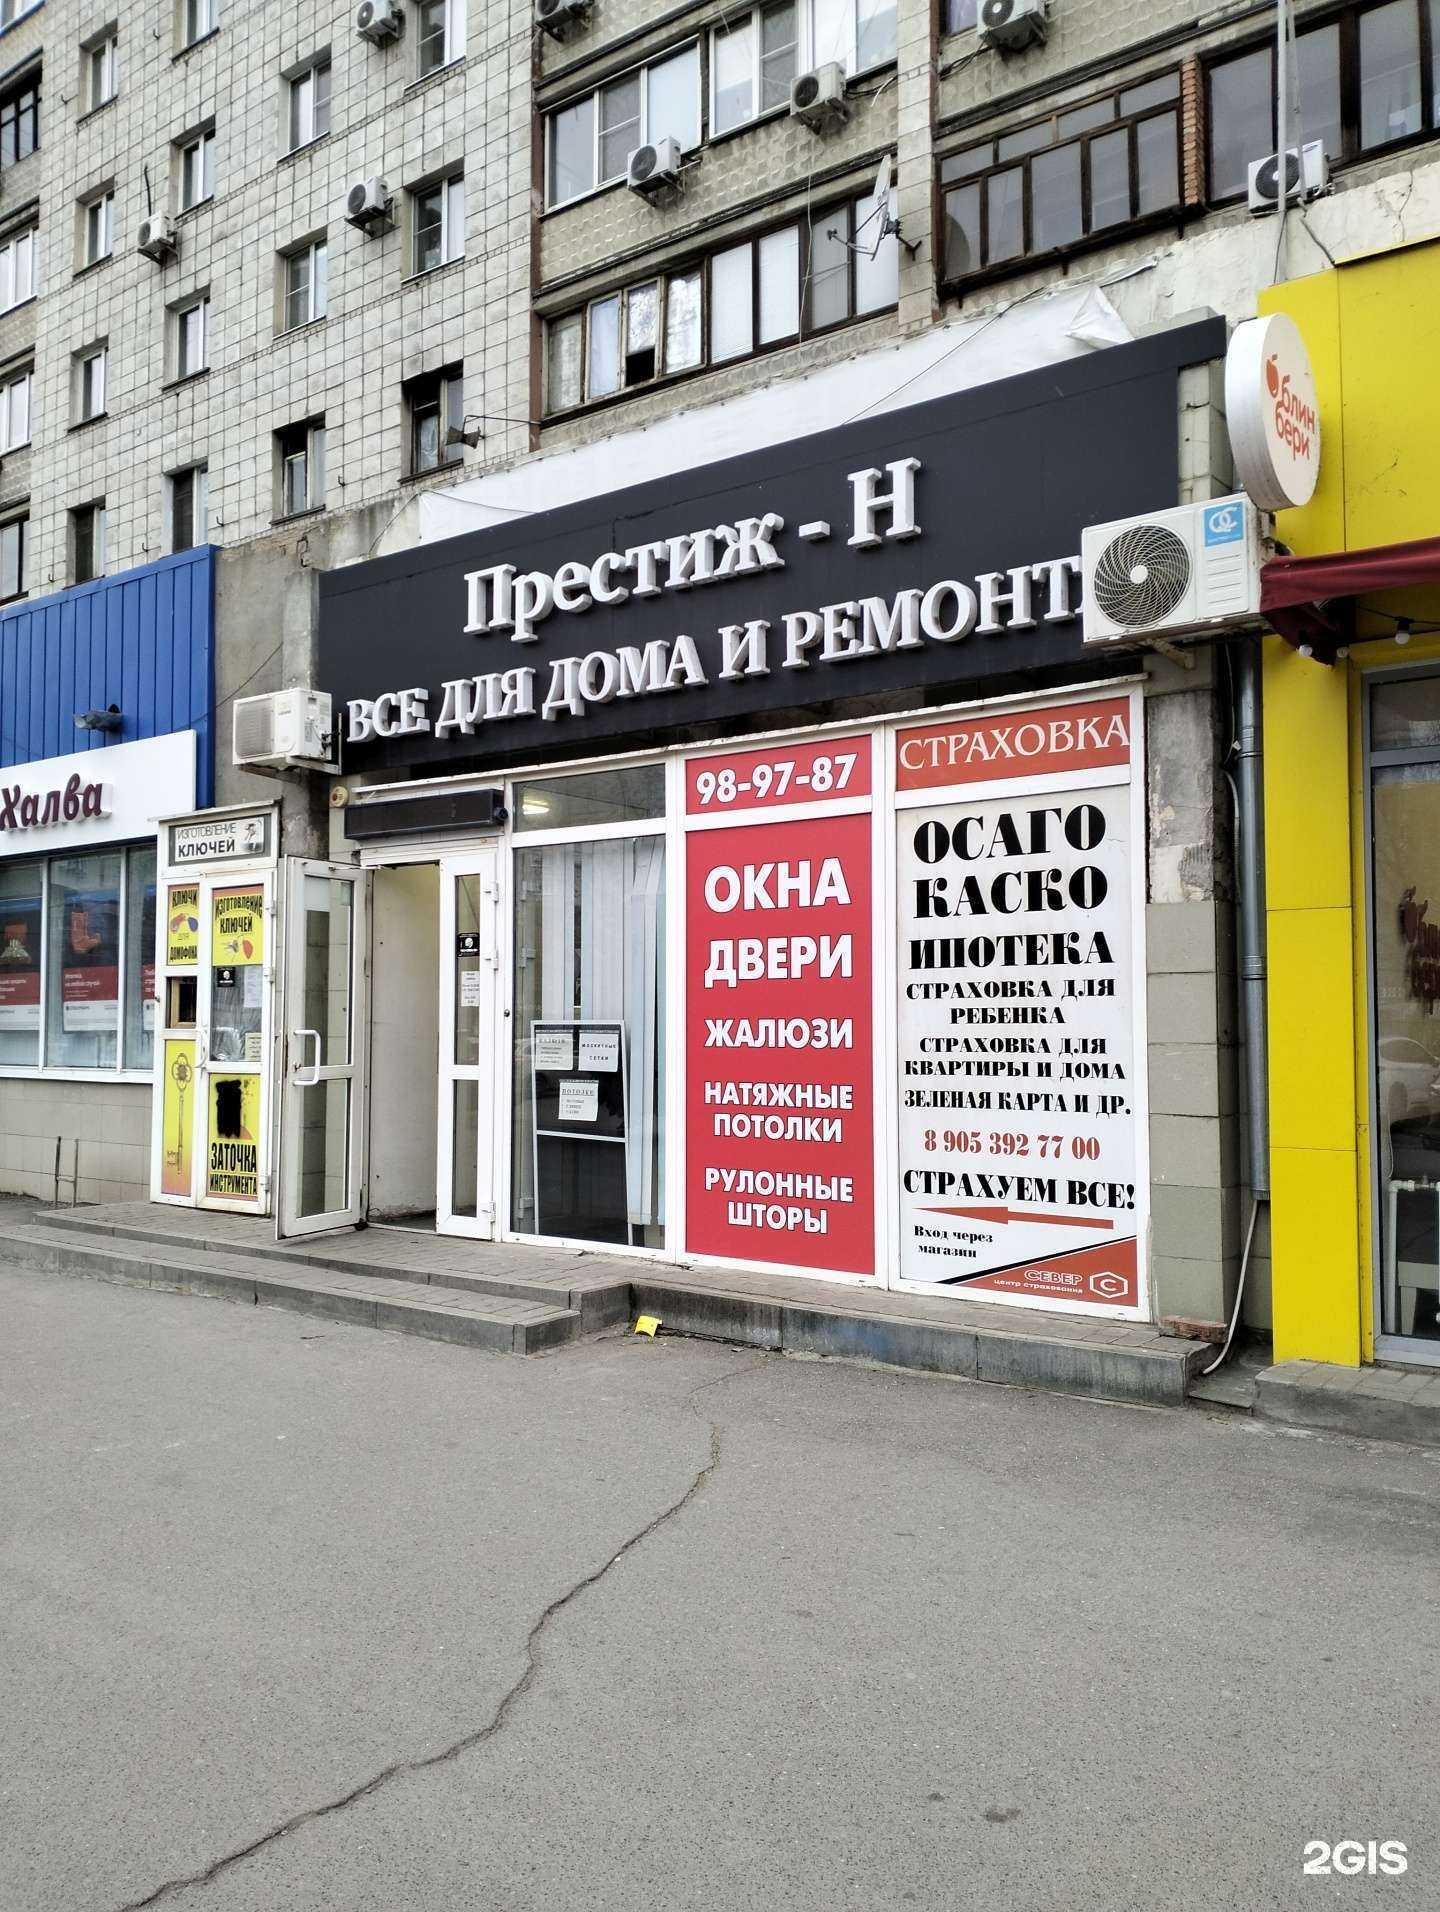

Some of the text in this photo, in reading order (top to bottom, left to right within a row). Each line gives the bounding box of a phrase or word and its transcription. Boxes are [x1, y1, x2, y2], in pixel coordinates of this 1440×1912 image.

[462, 511, 786, 643] Престиж
[847, 456, 922, 549] Н
[347, 687, 431, 743] ВСЕ
[434, 666, 537, 739] ДЛЯ
[541, 634, 709, 721] ДОМА
[718, 619, 772, 680] И
[900, 714, 1131, 770] СТРАХОВКА
[695, 752, 858, 805] 98-97-87
[0, 773, 103, 832] Халва
[178, 836, 236, 858] КЛЮЧЕЙ
[913, 803, 1107, 864] ОСАГО
[704, 856, 853, 914] ОКНА
[912, 865, 1109, 920] КАСКО
[219, 911, 253, 934] КЛЮЧЕЙ
[704, 934, 853, 989] ДВЕРИ
[908, 930, 1115, 970] ИПОТЕКА
[906, 978, 1117, 1001] СТРАХОВКА ДЛЯ
[950, 1006, 1067, 1025] РЕБЕНКА
[704, 1018, 854, 1049] ЖАЛЮЗИ
[919, 1037, 1107, 1058] СТРАХОВКА ДЛЯ
[904, 1060, 1126, 1082] КВАРТИРЫ И ДОМА
[704, 1081, 854, 1111] НАТЯЖНЫЕ
[904, 1089, 1132, 1119] ЗЕЛЕНАЯ КАРТА И ДР.
[713, 1113, 843, 1144] ПОТОЛКИ
[211, 1142, 257, 1174] ЗАТОЧКА
[924, 1129, 1101, 1161] 8 905 392 77 00
[209, 1174, 258, 1195] ИНСТРУМЕНТА
[704, 1167, 854, 1203] РУЛОННЫЕ
[903, 1169, 1136, 1211] СТРАХУЕМ ВСЕ!
[727, 1201, 829, 1235] ШТОРЫ
[914, 1225, 994, 1244] Вход через
[918, 1244, 978, 1259] магазин
[994, 1278, 1084, 1294] центр страхования
[1024, 1269, 1083, 1286] СЕВЕР
